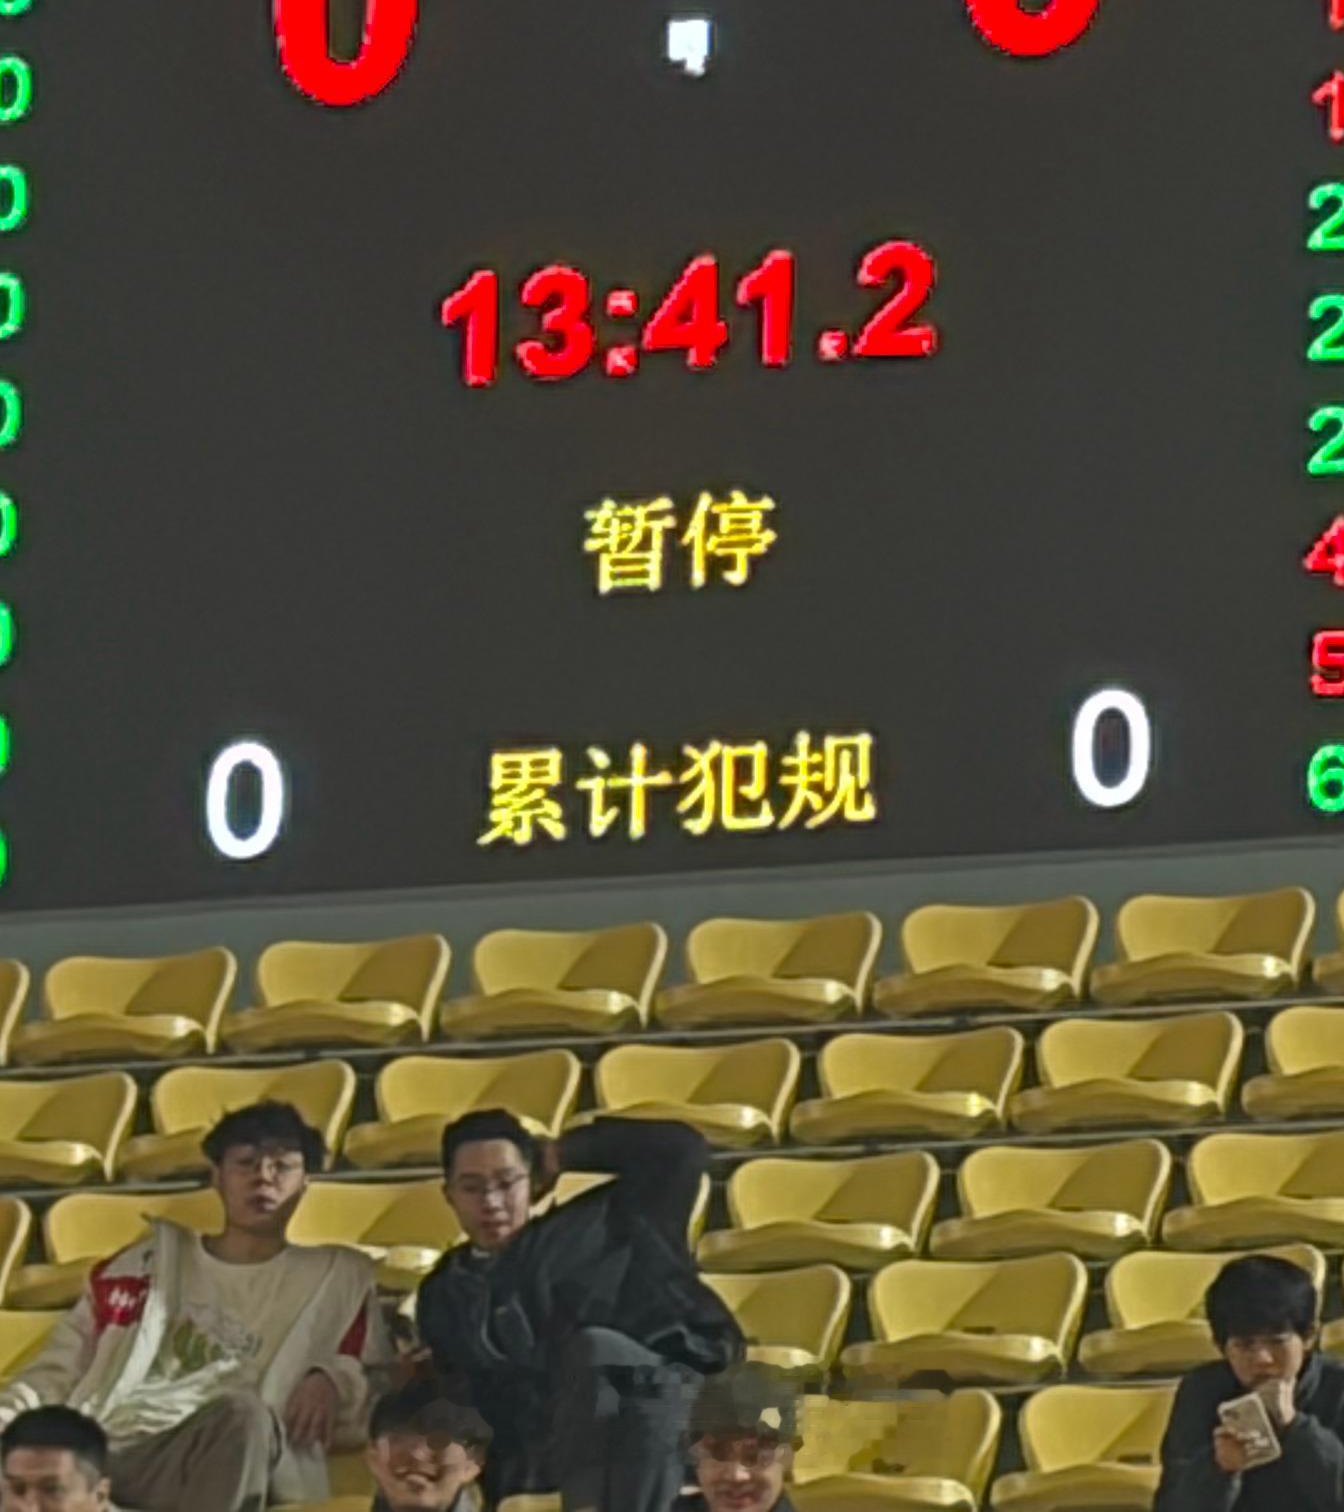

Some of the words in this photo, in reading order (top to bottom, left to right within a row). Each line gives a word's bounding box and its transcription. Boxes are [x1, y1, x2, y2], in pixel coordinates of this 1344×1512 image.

[441, 241, 937, 386] 13:41.2
[584, 490, 777, 594] 暂停
[206, 739, 285, 859] 0
[477, 731, 877, 845] 累计犯规
[1072, 687, 1151, 807] 0
